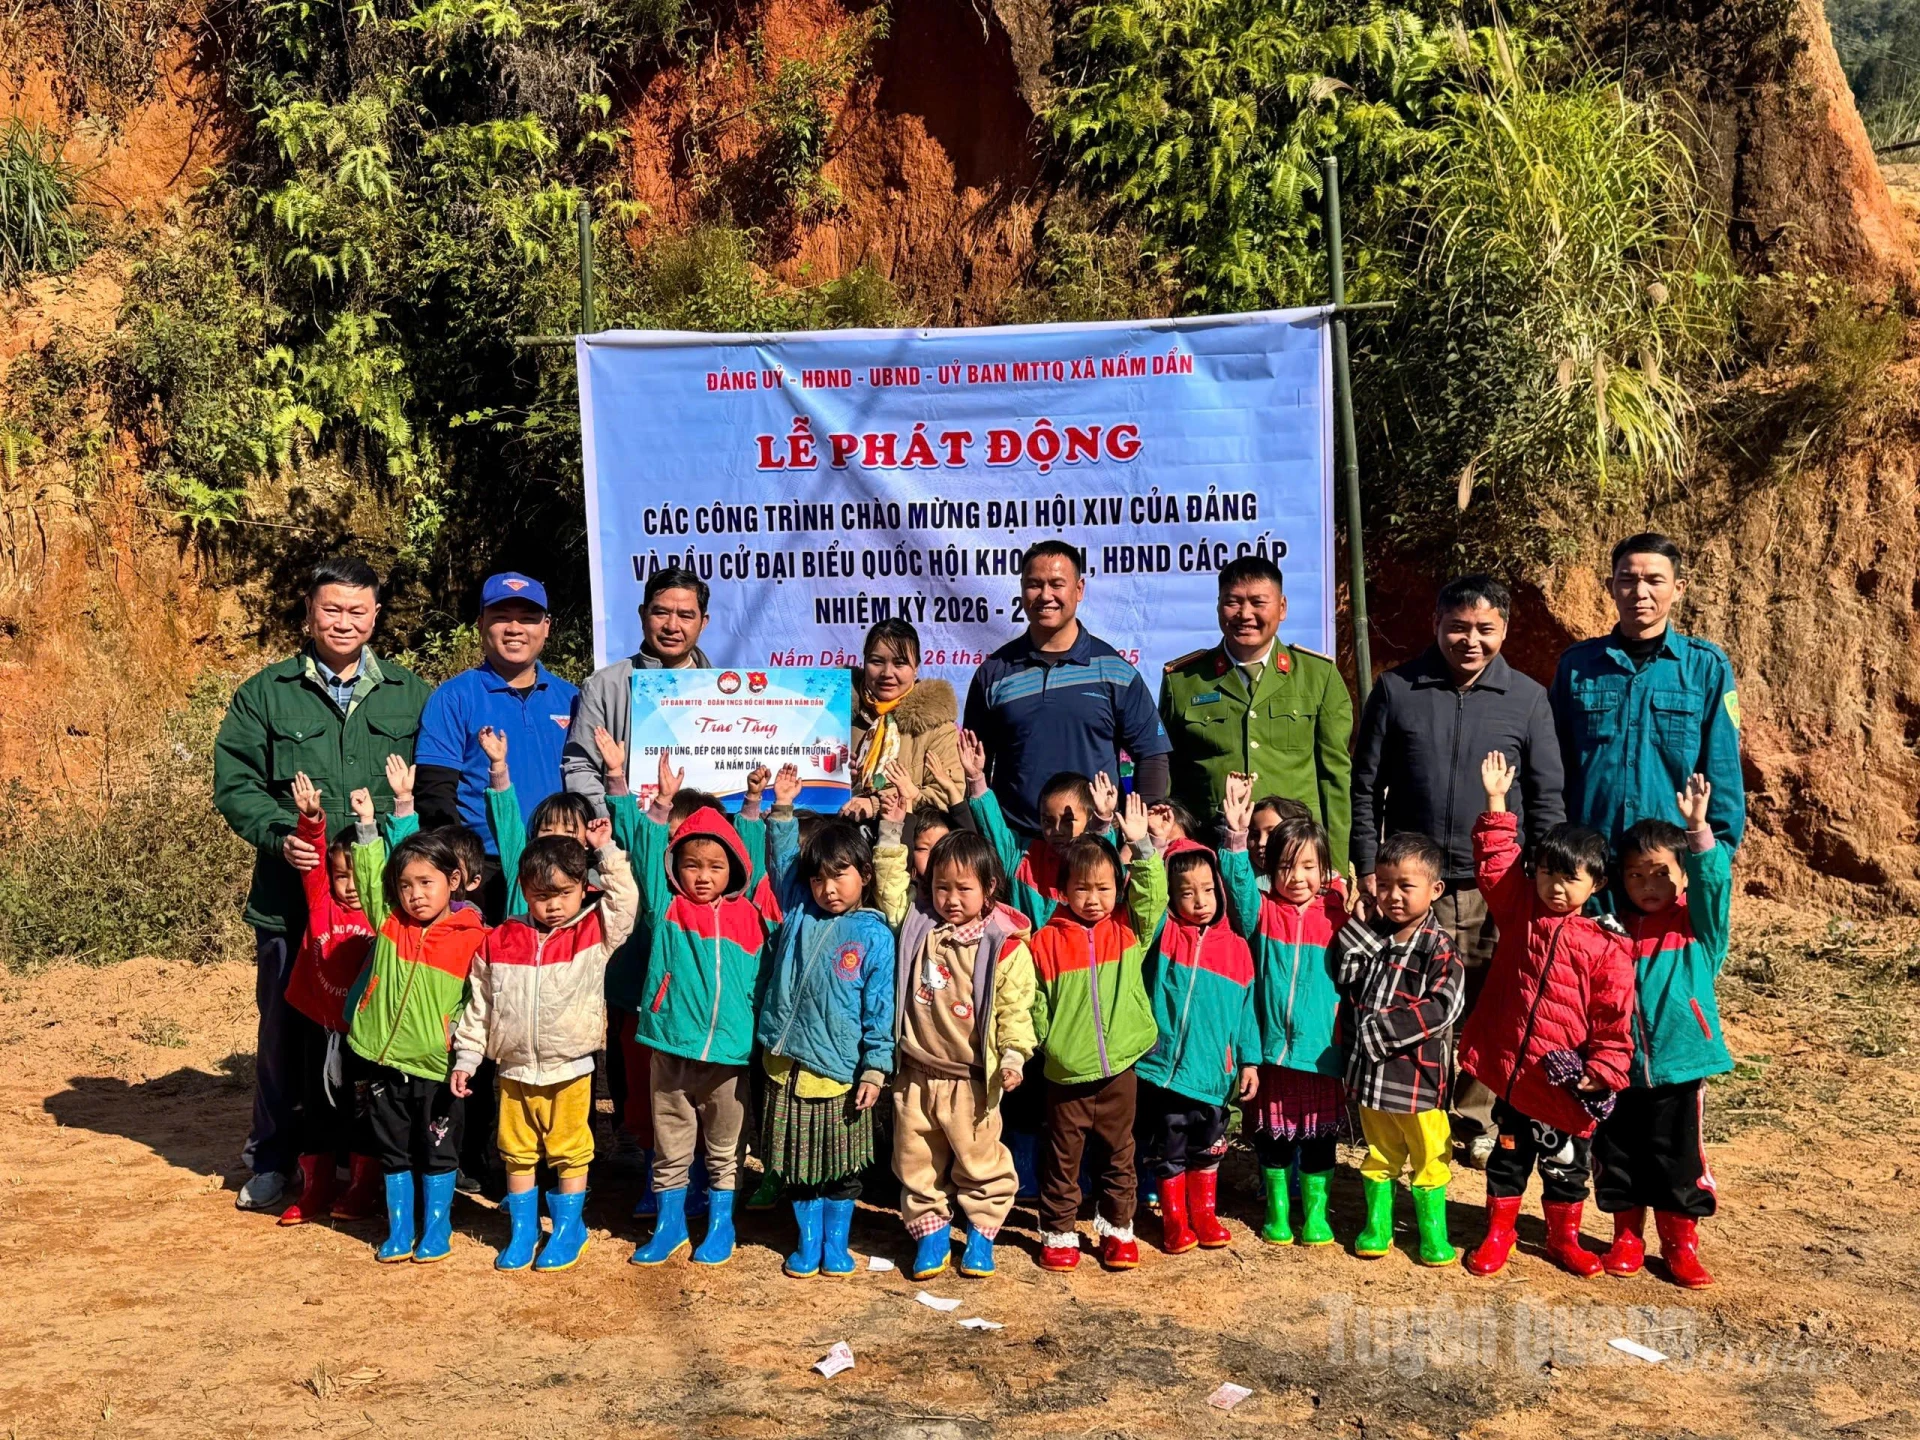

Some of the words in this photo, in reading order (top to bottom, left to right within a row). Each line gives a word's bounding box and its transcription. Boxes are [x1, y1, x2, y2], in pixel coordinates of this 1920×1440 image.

[707, 366, 757, 391] ĐẢNG
[762, 363, 784, 389] UỶ
[801, 368, 852, 388] HĐND
[869, 366, 920, 387] UBND
[938, 358, 961, 385] UỶ
[967, 363, 1007, 384] BAN
[1012, 360, 1064, 382] MTTQ
[1070, 355, 1096, 379] XÃ
[1101, 350, 1147, 378] NẤM
[1152, 347, 1193, 375] DẨN
[756, 416, 818, 470] LỄ
[827, 422, 974, 469] PHÁT
[986, 418, 1142, 472] ĐỘNG
[643, 502, 689, 535] CÁC
[695, 501, 758, 534] CÔNG
[764, 499, 834, 532] TRÌNH
[841, 498, 900, 530] CHÀO
[908, 497, 980, 529] MỪNG
[987, 500, 1027, 534] ĐẠI
[1036, 494, 1076, 533] HỘI
[1083, 498, 1122, 525] XIV
[1130, 487, 1180, 524] CỦA
[1187, 485, 1257, 523] ĐẢNG
[720, 544, 751, 579] CỬ
[756, 552, 795, 584] ĐẠI
[802, 540, 854, 577] BIỂU
[862, 540, 923, 579] QUỐC
[929, 544, 968, 582] HỘI
[975, 546, 1026, 576] KHO
[1103, 545, 1171, 573] HĐND
[1179, 538, 1228, 572] CÁC
[815, 592, 891, 629] NHIỆM
[900, 591, 927, 623] KỲ
[934, 597, 988, 623] 2026
[769, 648, 813, 667] Nấm
[924, 650, 946, 666] 26
[695, 717, 733, 733] Trao
[736, 717, 778, 739] Tặng
[645, 746, 658, 755] 550
[694, 745, 709, 755] DÉP
[710, 746, 725, 755] CHO
[728, 746, 742, 757] HỌC
[744, 746, 762, 755] SINH
[764, 745, 779, 755] CÁC
